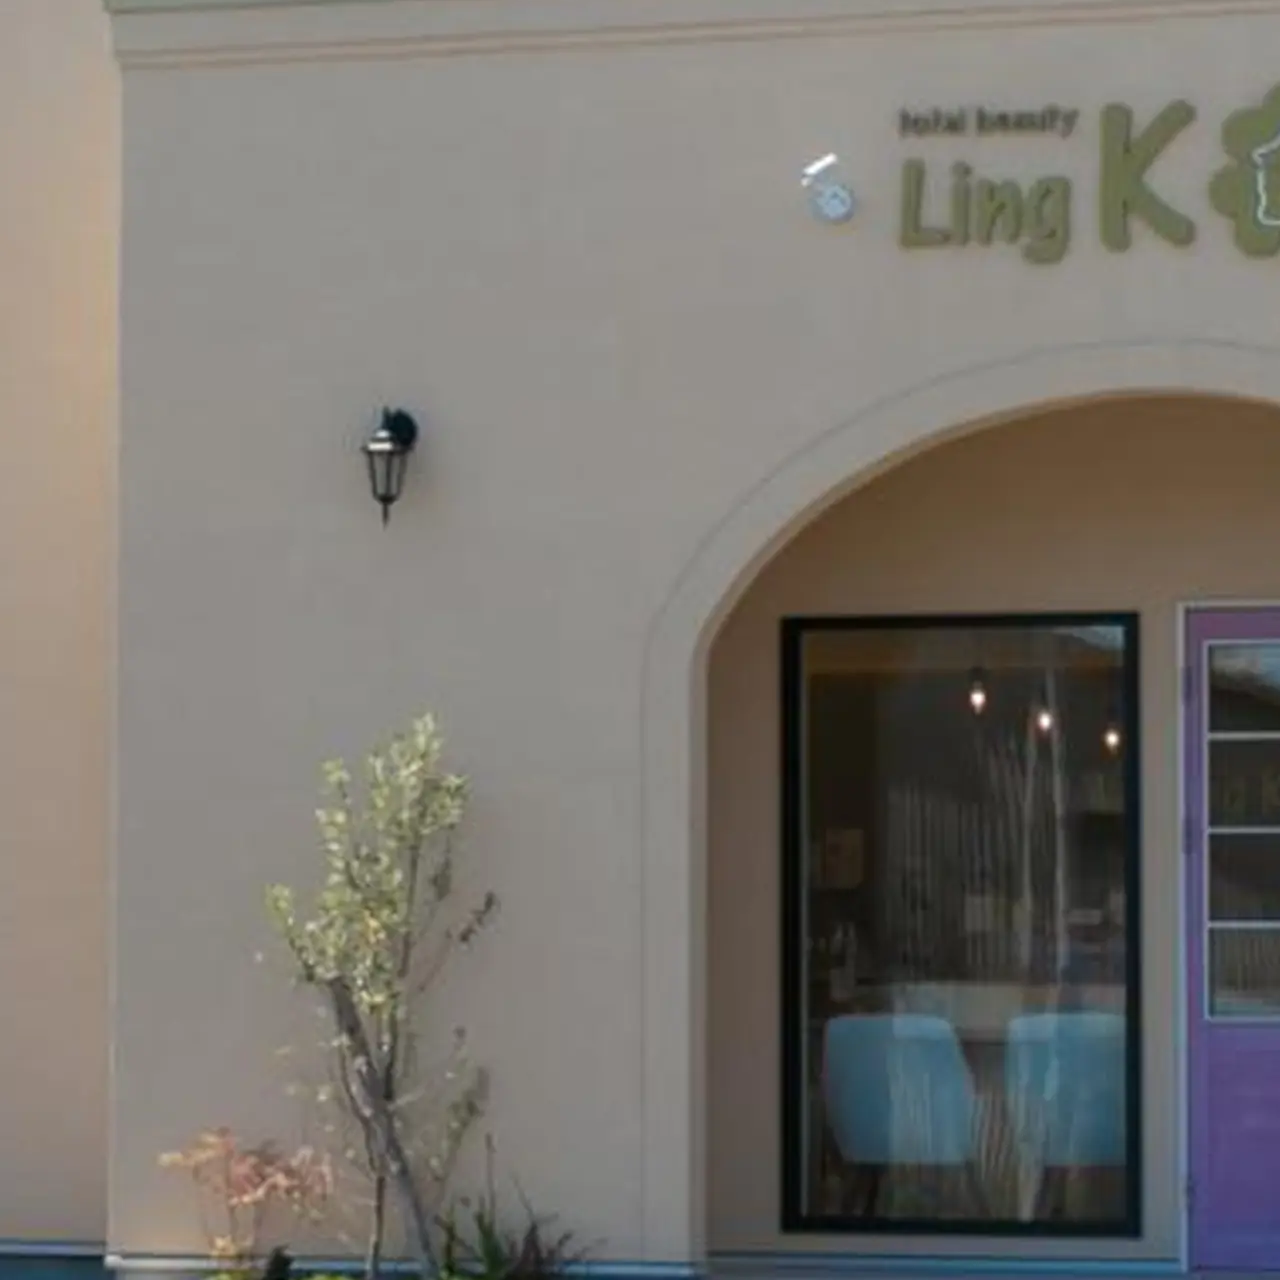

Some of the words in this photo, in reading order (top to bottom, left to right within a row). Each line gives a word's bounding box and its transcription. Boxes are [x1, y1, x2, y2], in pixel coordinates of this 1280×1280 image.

[976, 104, 1078, 139] beauty
[899, 159, 1072, 265] Ling
[1100, 100, 1196, 252] K
